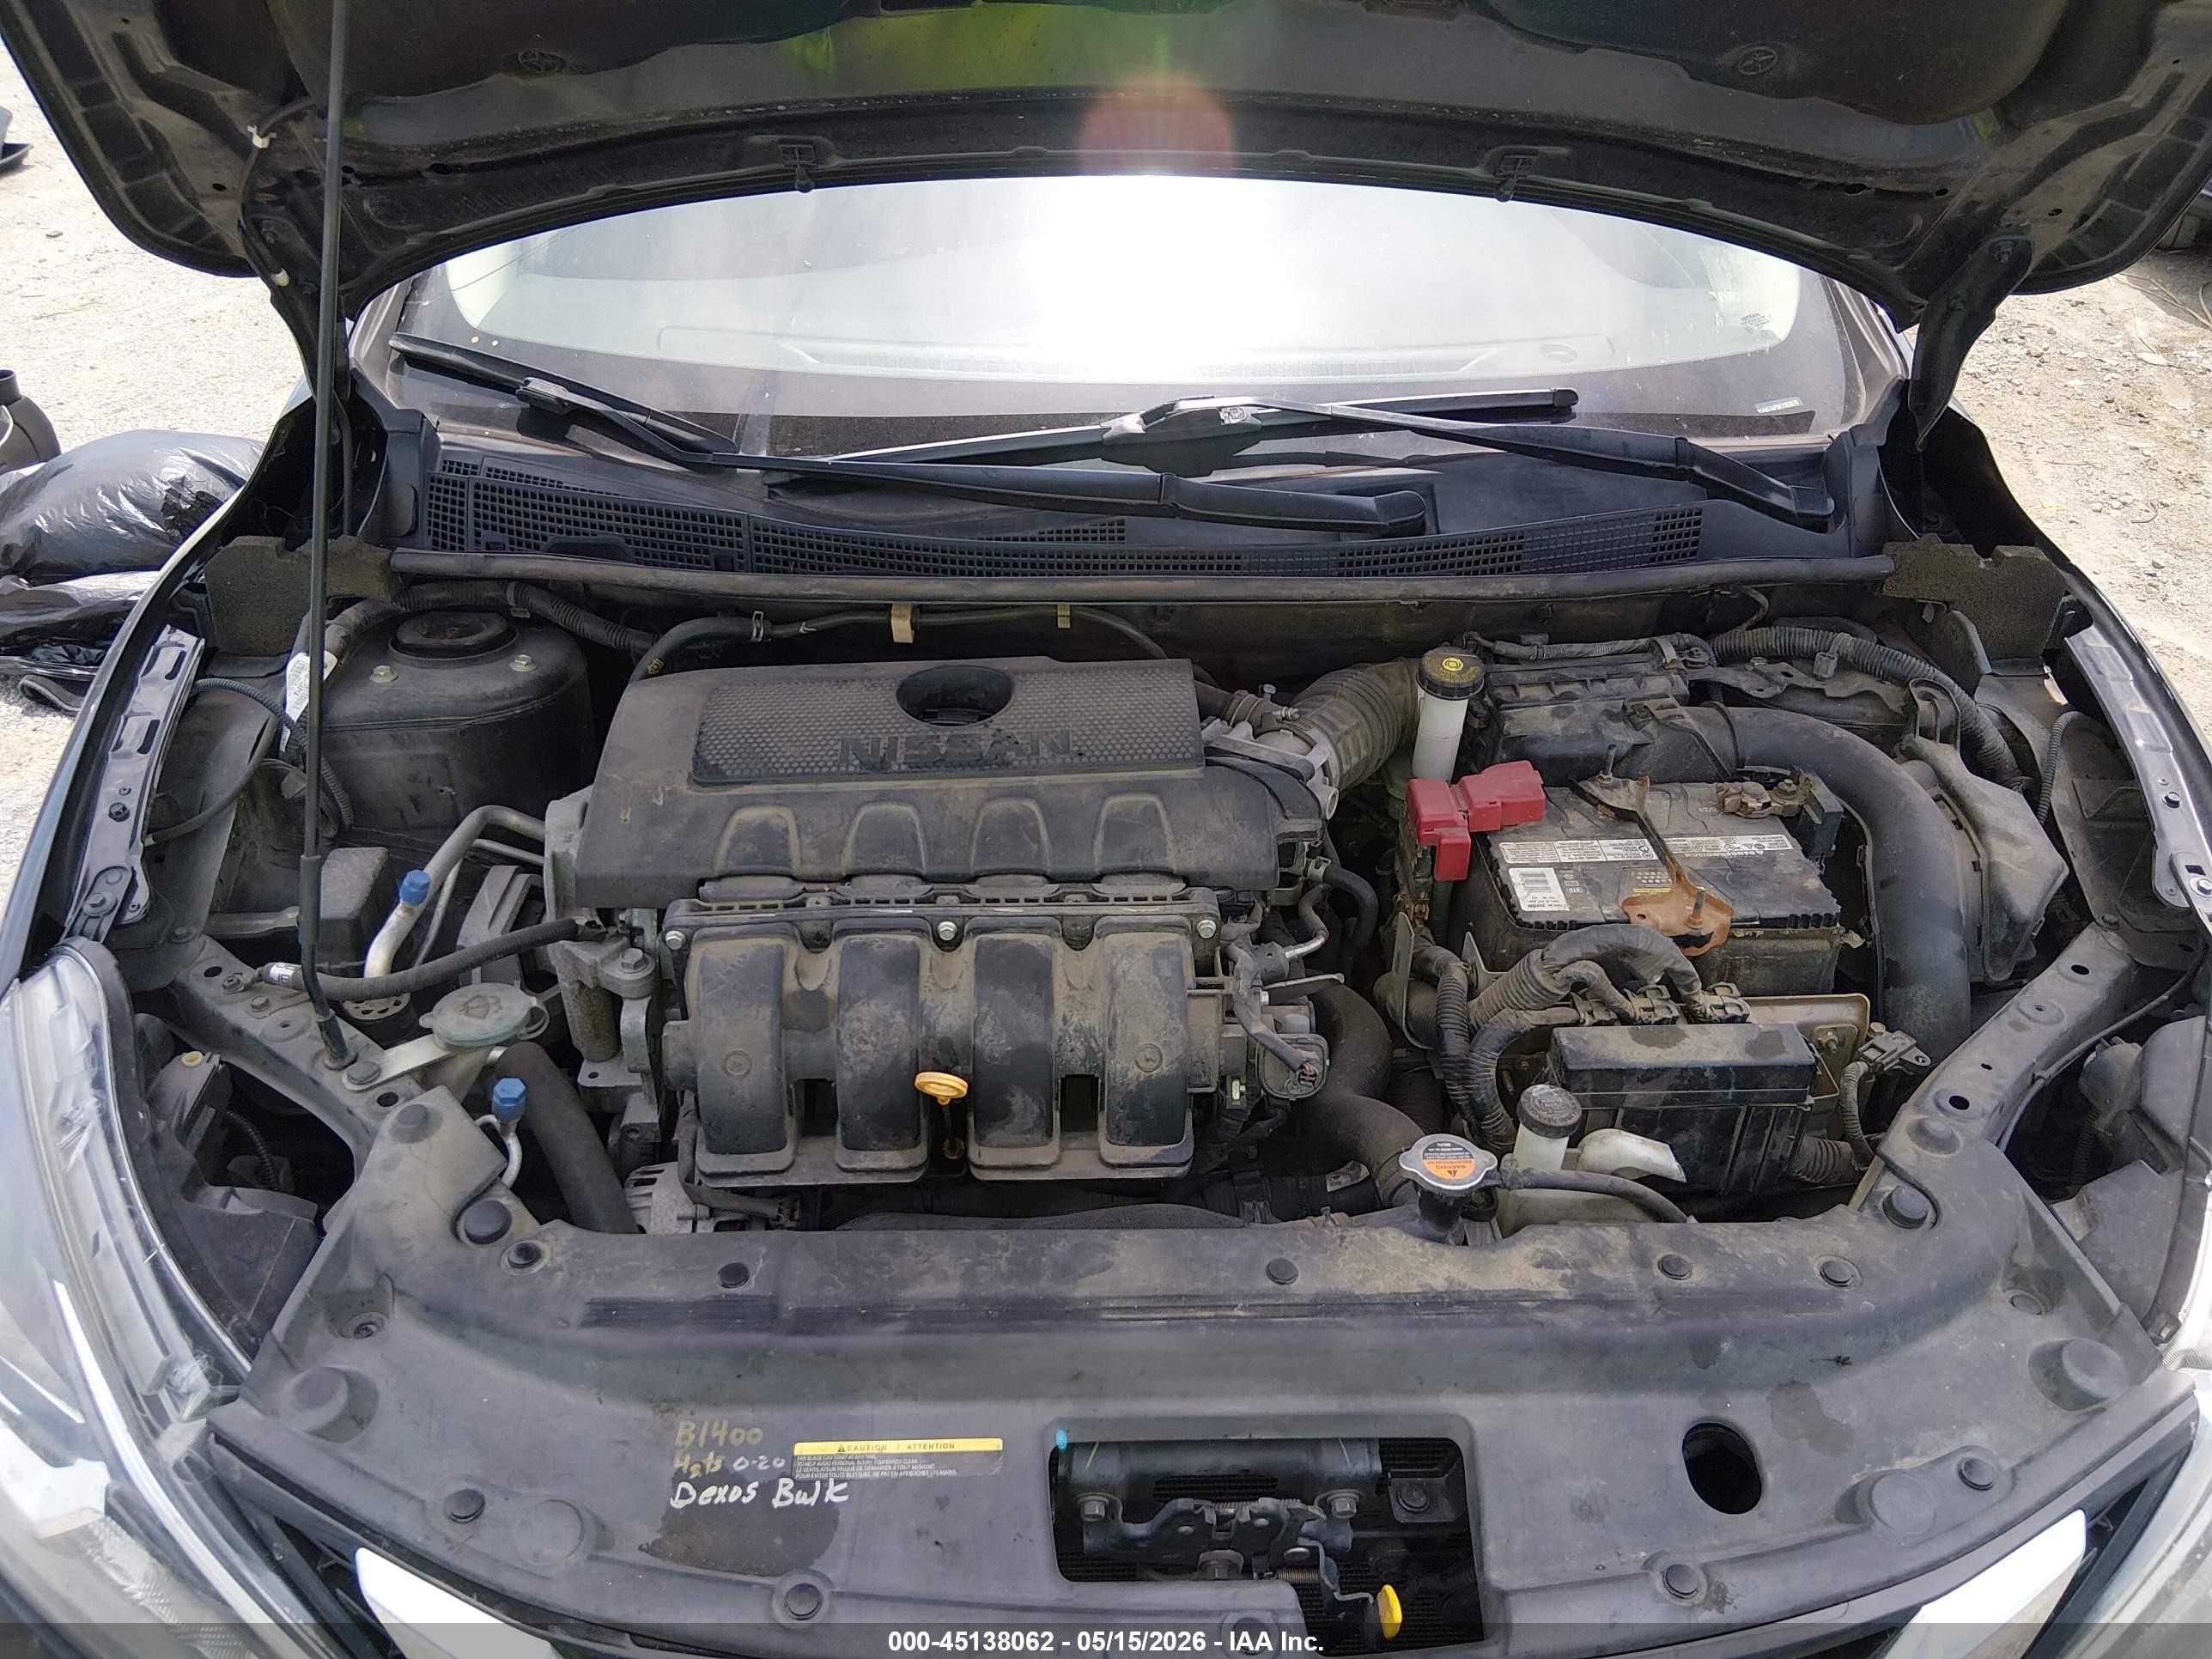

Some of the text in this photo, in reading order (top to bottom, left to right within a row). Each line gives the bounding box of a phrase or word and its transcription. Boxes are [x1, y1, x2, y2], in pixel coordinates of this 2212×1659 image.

[841, 729, 1071, 771] NISSAN
[670, 1477, 849, 1509] Dexos Bulk
